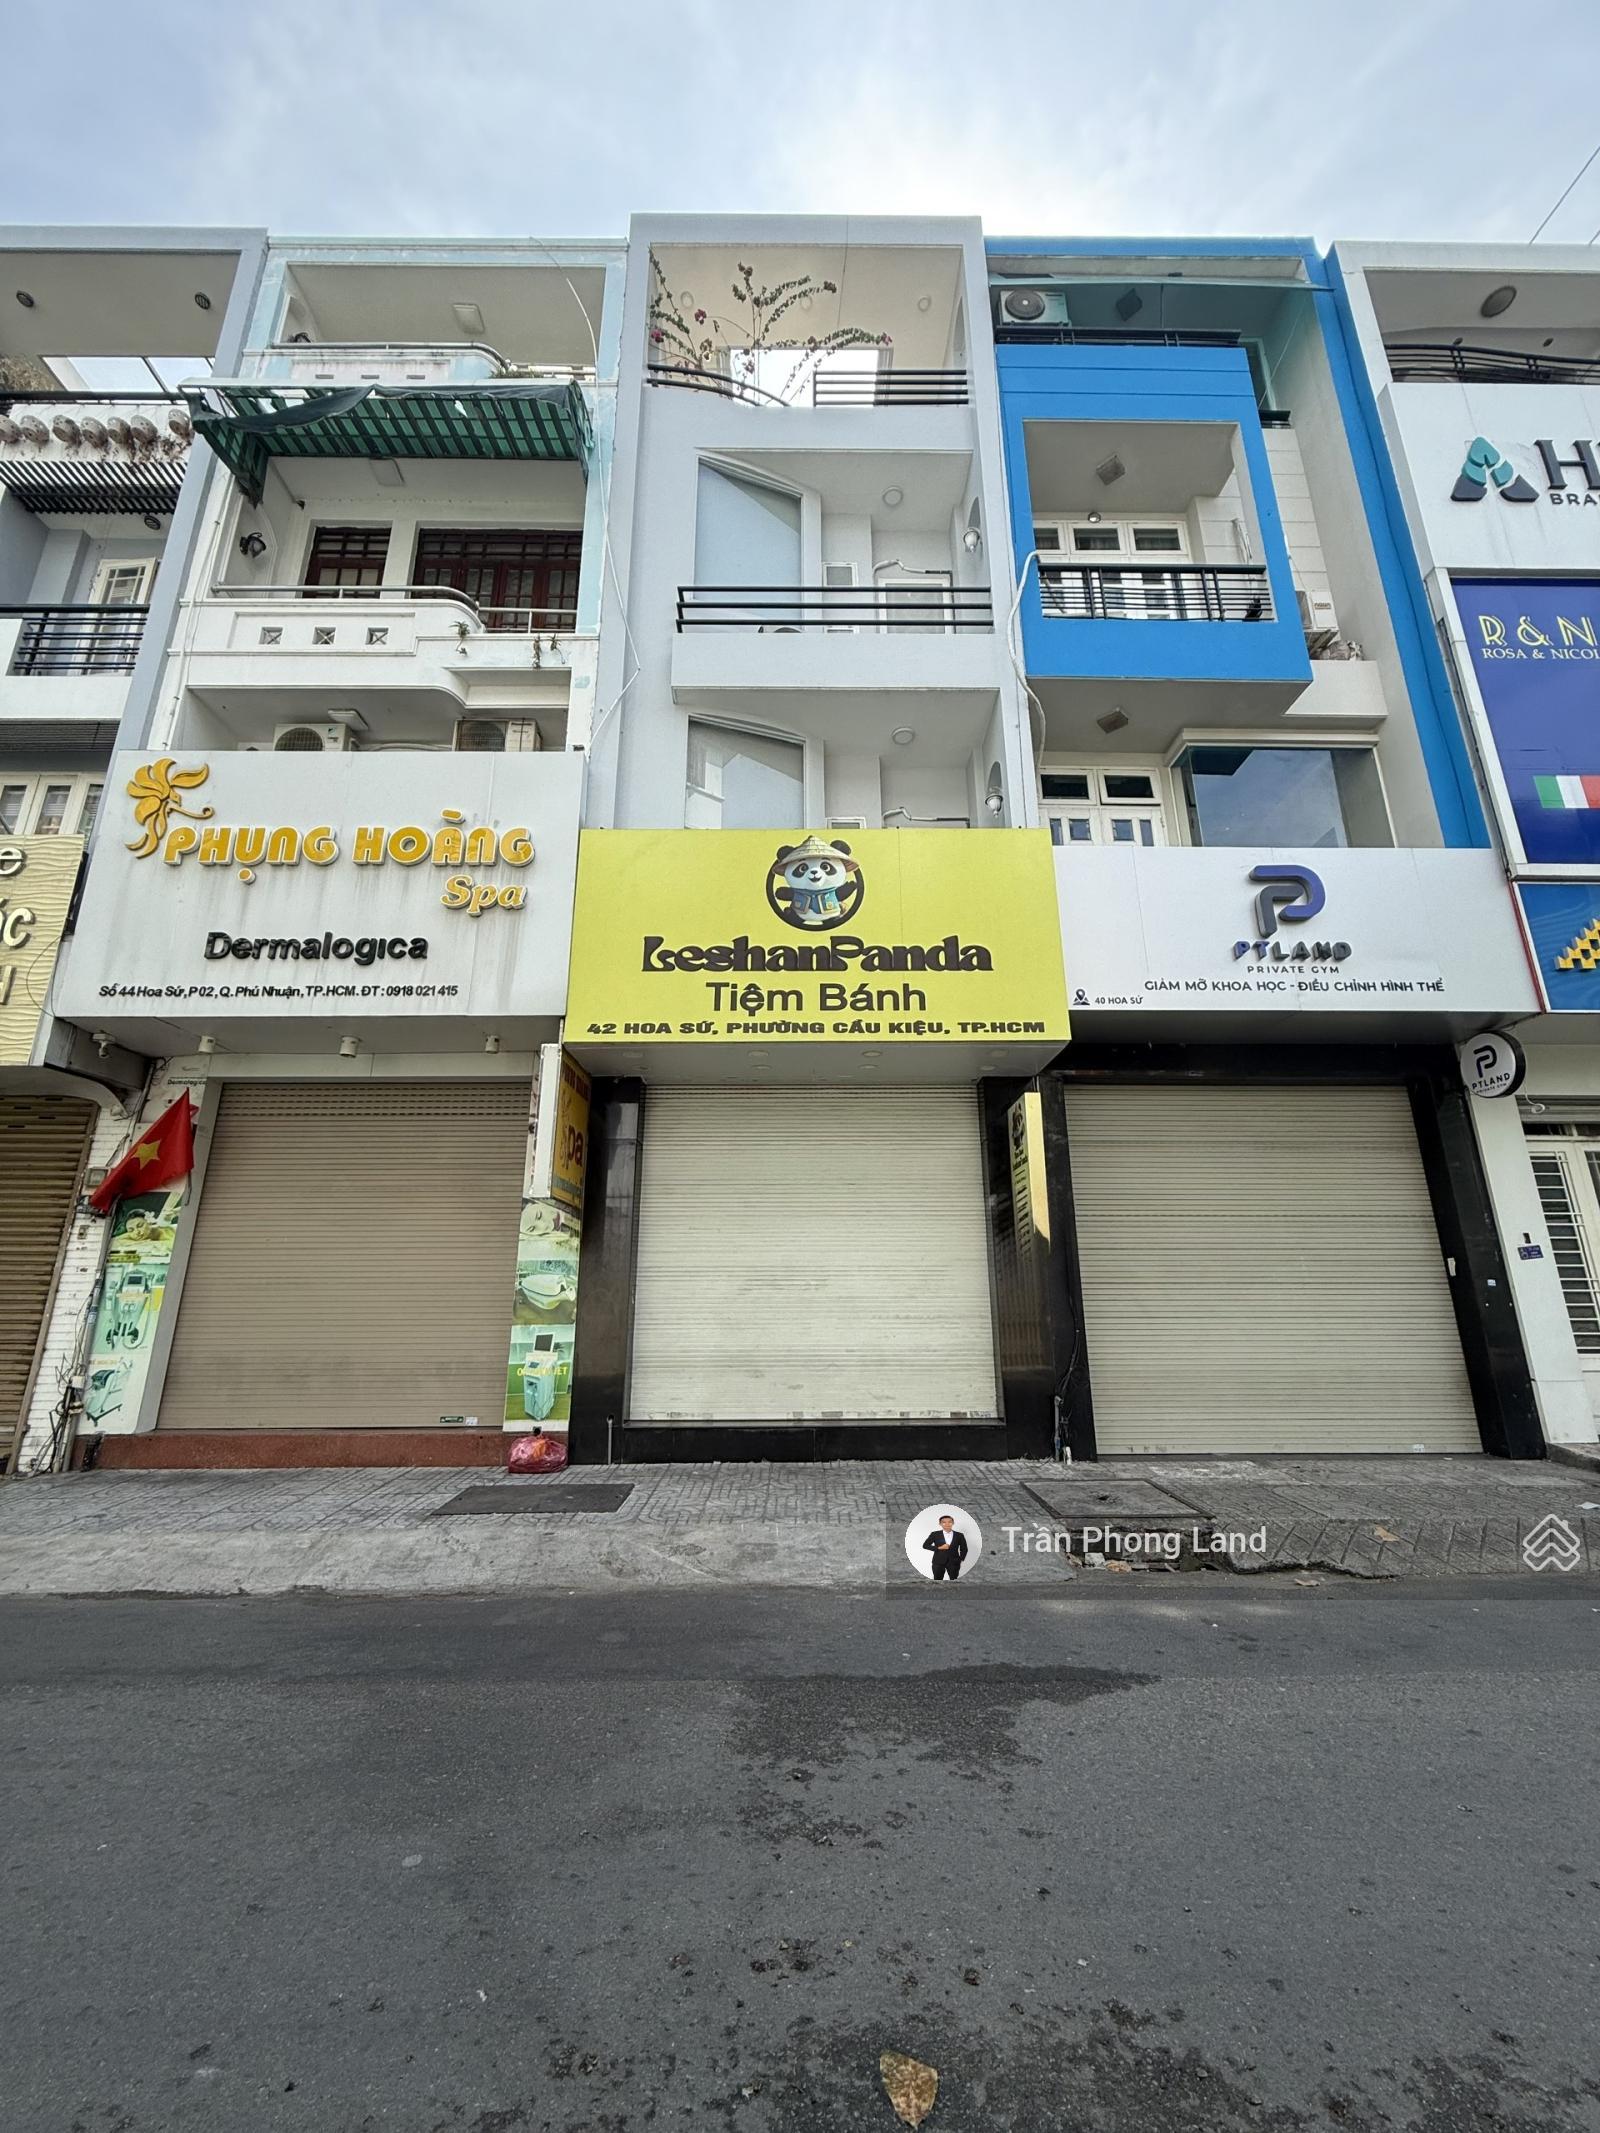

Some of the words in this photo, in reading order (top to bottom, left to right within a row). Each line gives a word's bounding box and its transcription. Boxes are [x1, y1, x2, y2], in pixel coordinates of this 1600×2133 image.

[1533, 439, 1600, 490] H
[1549, 493, 1600, 506] BRA
[1479, 615, 1507, 646] R
[1517, 615, 1554, 646] &
[1557, 615, 1598, 646] N
[1482, 648, 1528, 659] ROSA
[1532, 648, 1546, 659] &
[163, 825, 340, 885] PHỤNG
[352, 808, 536, 867] HOÀNG
[440, 874, 528, 917] Spa
[204, 931, 430, 966] Dermalogica
[641, 935, 994, 972] LeshanPanda
[1232, 940, 1353, 961] PTLAND
[1247, 965, 1305, 974] PRIVATE
[1311, 965, 1340, 974] GYM
[99, 983, 119, 997] Số
[118, 985, 136, 997] 44
[136, 985, 163, 997] Hoa
[219, 985, 234, 997] Q.
[235, 985, 260, 997] Phú
[261, 985, 304, 999] Nhuận,
[305, 985, 359, 997] TP.HCM.
[386, 985, 413, 997] 0918
[415, 985, 436, 997] 021
[437, 985, 458, 997] 415
[1144, 977, 1181, 991] GIẢM
[1185, 978, 1209, 991] MỠ
[1212, 981, 1252, 991] KHOA
[1256, 980, 1287, 994] HỌC
[1334, 978, 1377, 991] CHỈNH
[1381, 978, 1414, 991] HÌNH
[705, 981, 804, 1017] Tiệm
[819, 982, 927, 1012] Bánh
[1094, 996, 1106, 1005] 40
[1108, 996, 1127, 1005] HOA
[587, 1022, 617, 1035] 42
[623, 1022, 672, 1034] HOA
[679, 1020, 719, 1036] SỨ,
[726, 1020, 826, 1035] PHƯỜNG
[888, 1019, 951, 1036] KIỆU,
[957, 1021, 1046, 1034] TP.HCM
[1472, 1072, 1511, 1090] PTLAND
